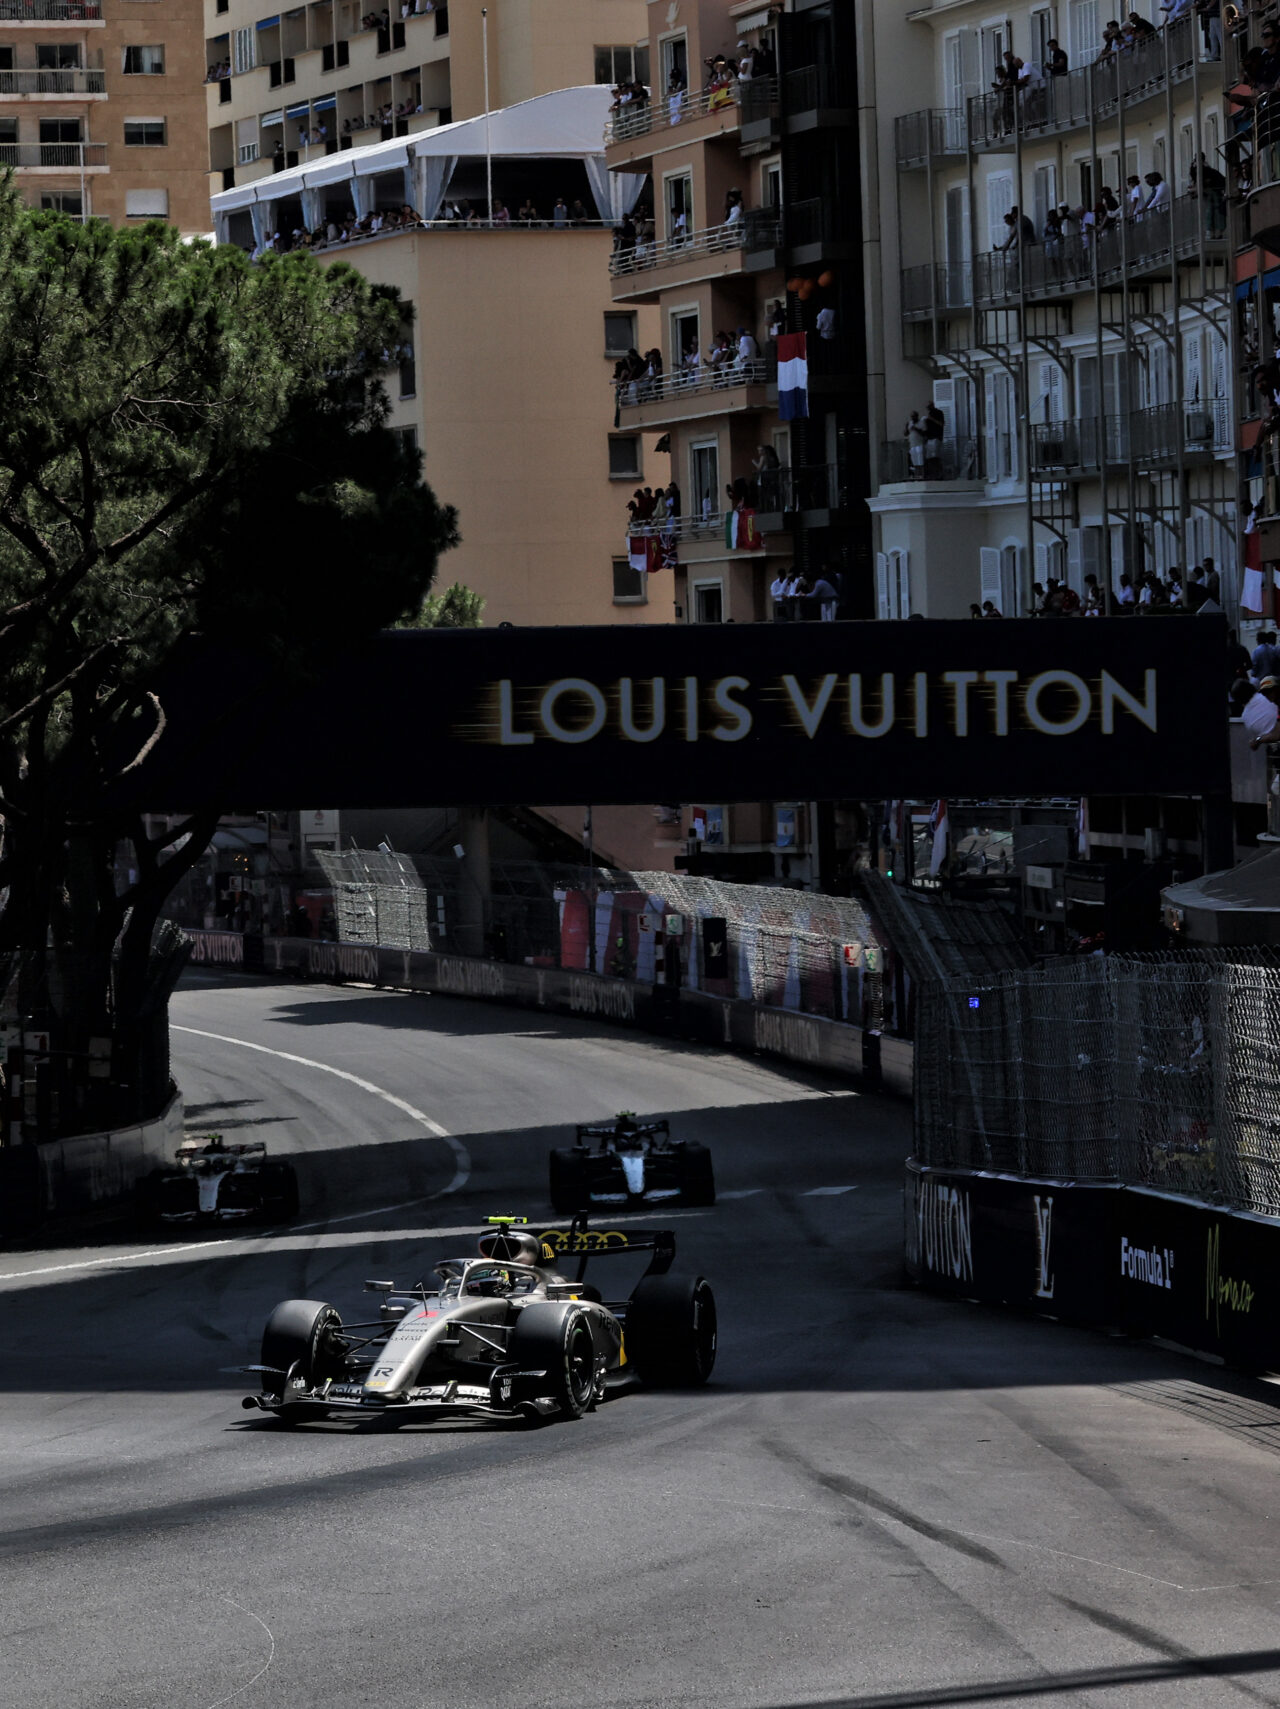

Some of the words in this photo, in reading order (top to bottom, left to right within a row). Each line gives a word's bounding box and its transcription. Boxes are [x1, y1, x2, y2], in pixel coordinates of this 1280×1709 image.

[499, 675, 753, 746] LOUIS
[783, 668, 1158, 739] VUITTON
[207, 934, 244, 963] VUITTON
[1120, 1236, 1163, 1288] Formula
[374, 1367, 394, 1377] R
